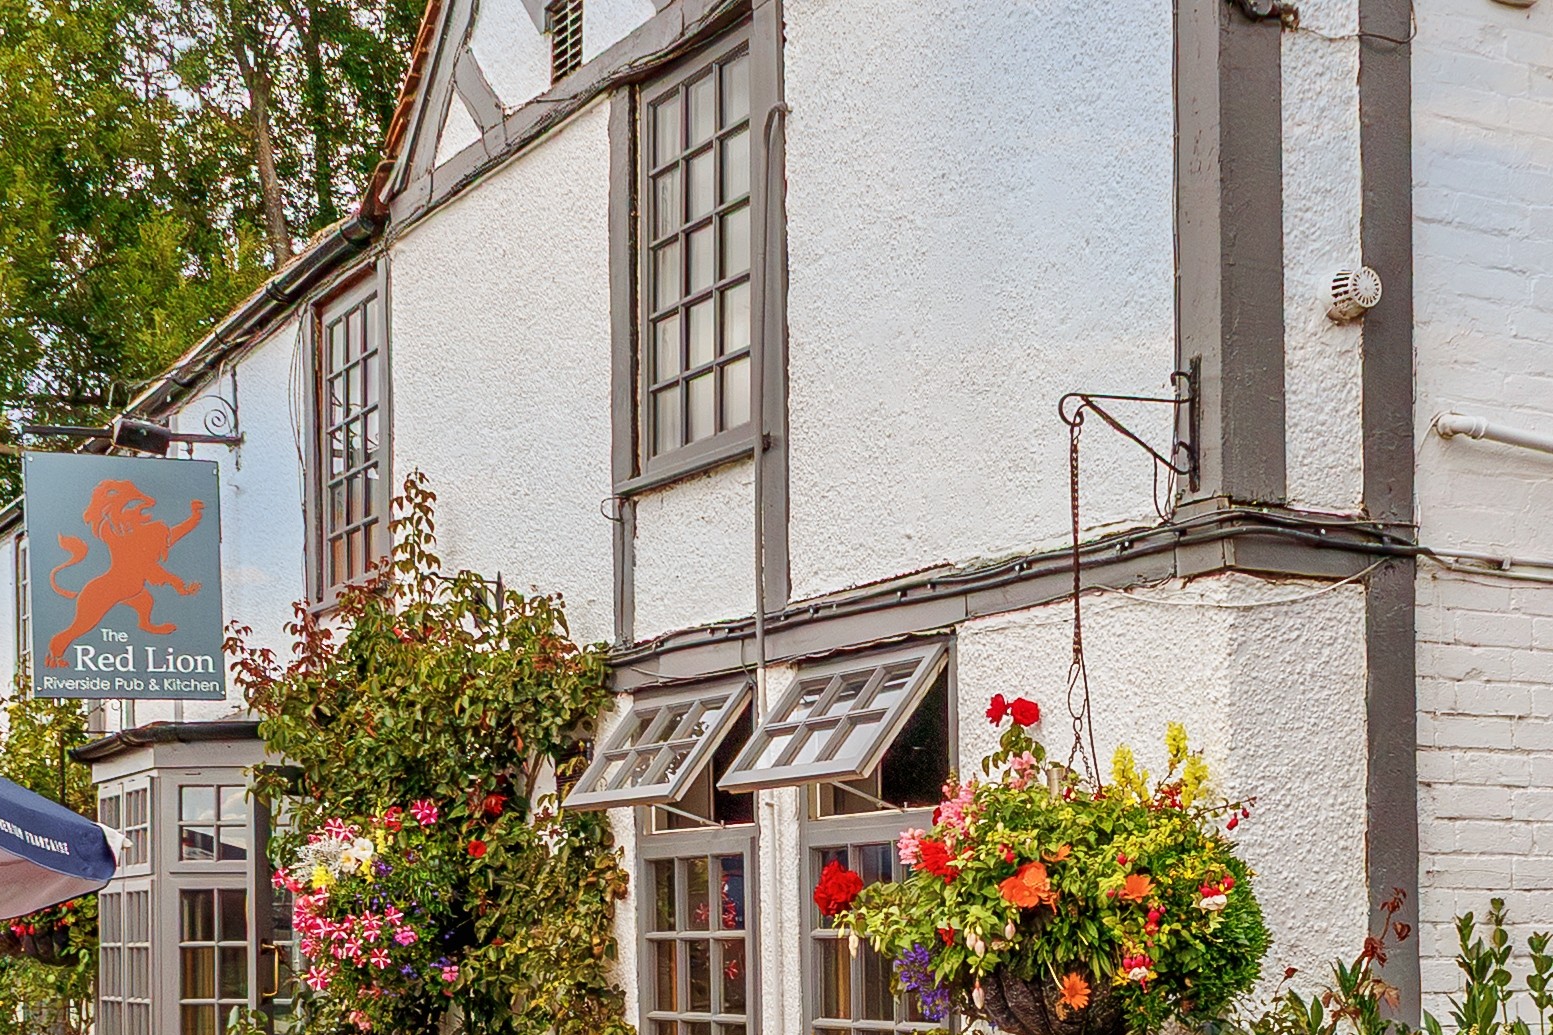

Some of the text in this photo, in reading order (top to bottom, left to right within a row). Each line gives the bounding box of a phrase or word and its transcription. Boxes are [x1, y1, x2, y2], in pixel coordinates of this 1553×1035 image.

[100, 629, 129, 642] The
[73, 645, 216, 673] Red Lion
[43, 676, 220, 692] Riverside Pub & Kitchen
